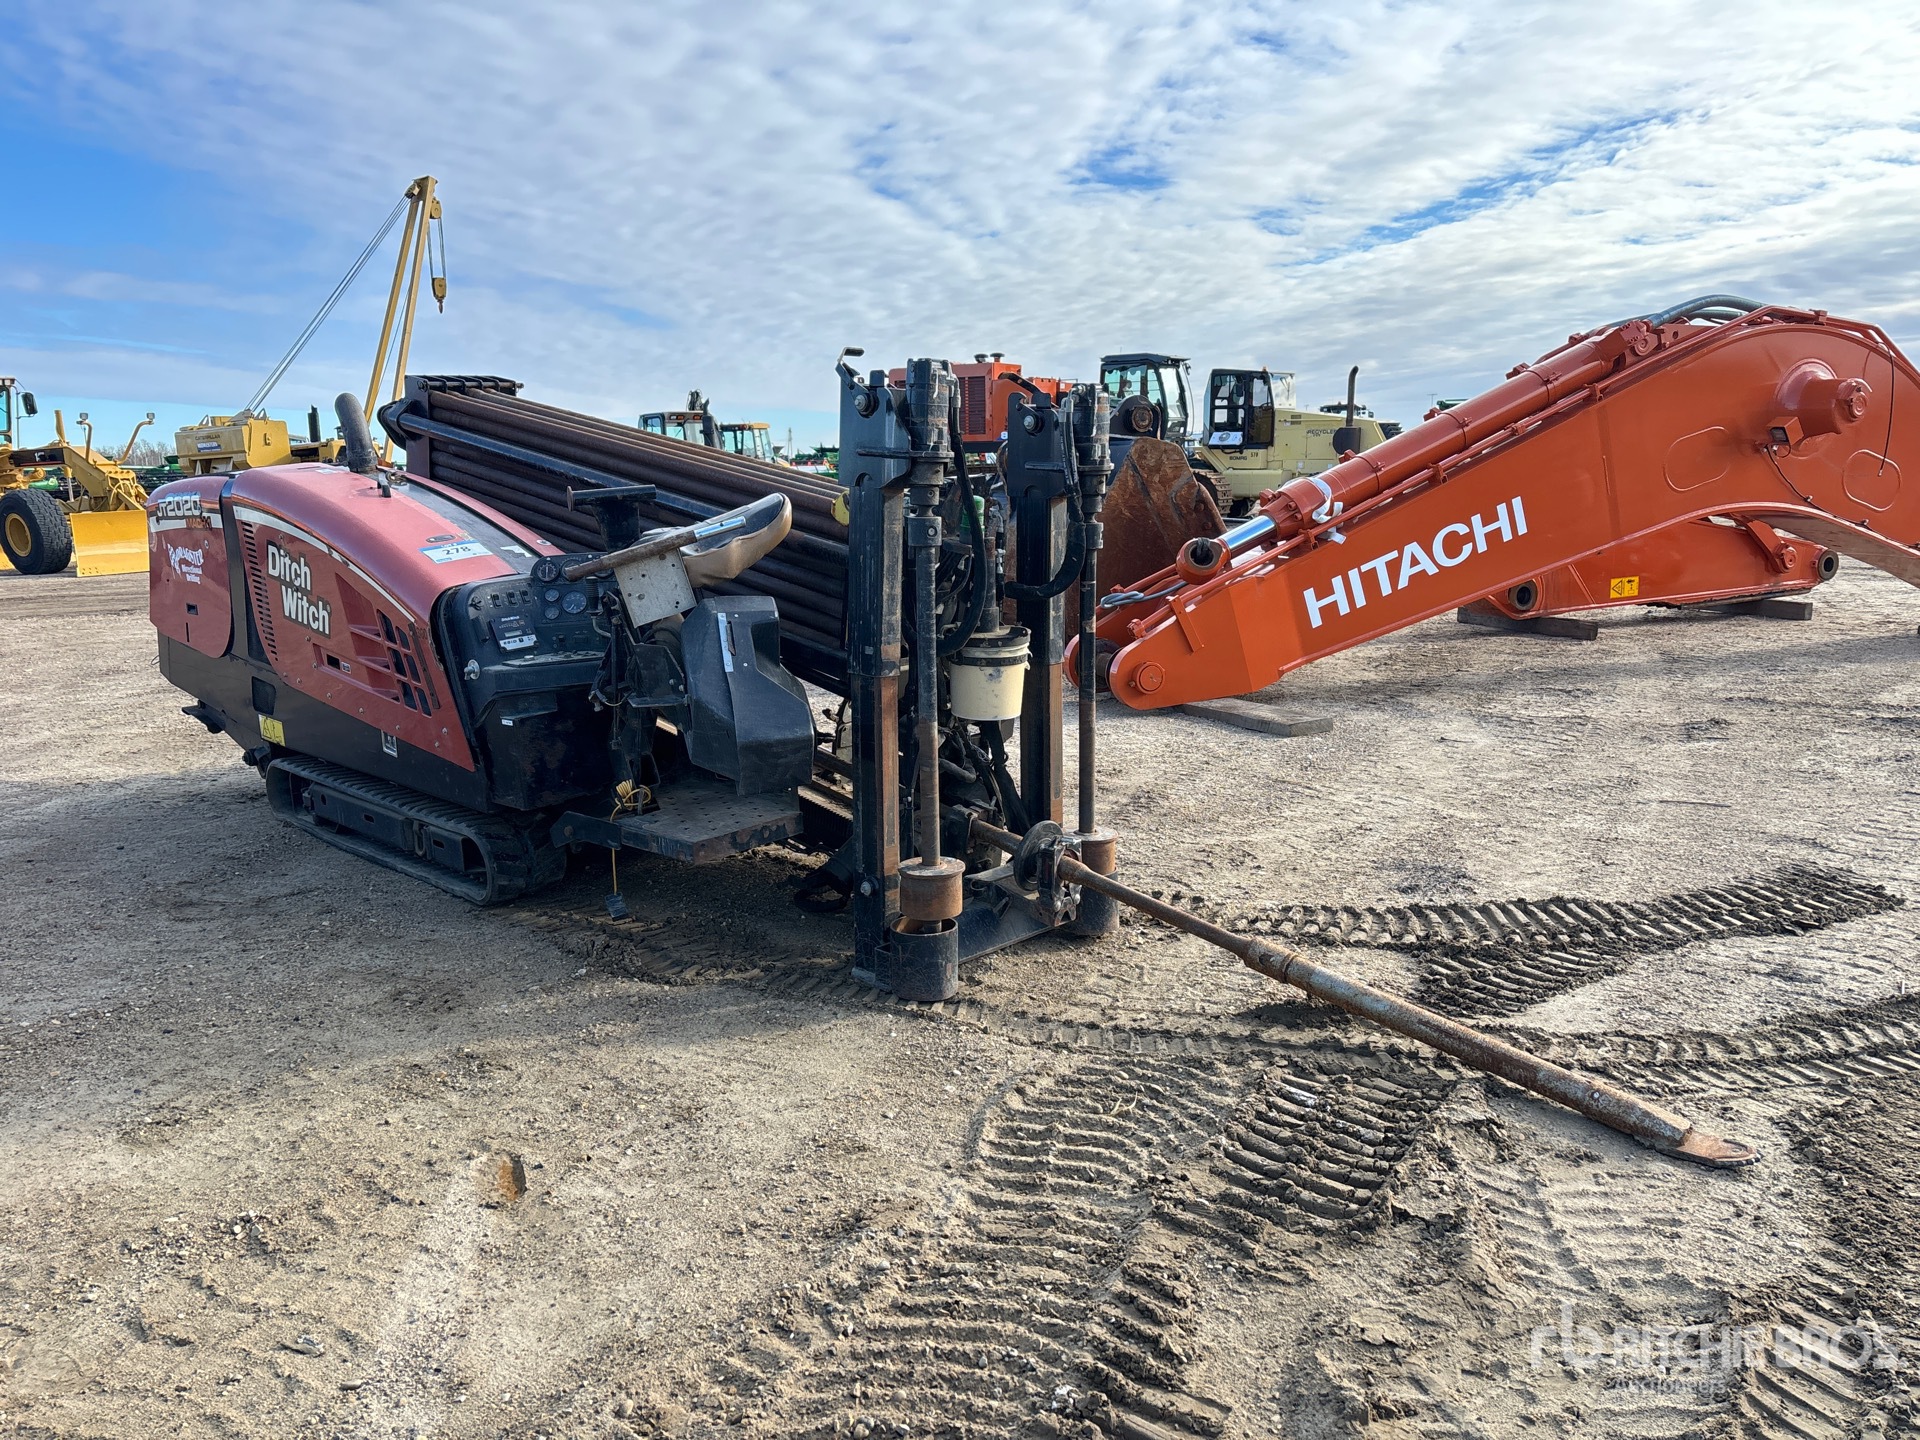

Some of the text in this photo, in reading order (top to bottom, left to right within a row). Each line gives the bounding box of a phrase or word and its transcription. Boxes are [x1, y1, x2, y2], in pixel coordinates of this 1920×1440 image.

[156, 495, 203, 517] JT2020
[268, 544, 311, 590] Ditch
[442, 546, 471, 555] 278
[1303, 495, 1528, 630] HITACHI
[281, 584, 330, 635] Witch
